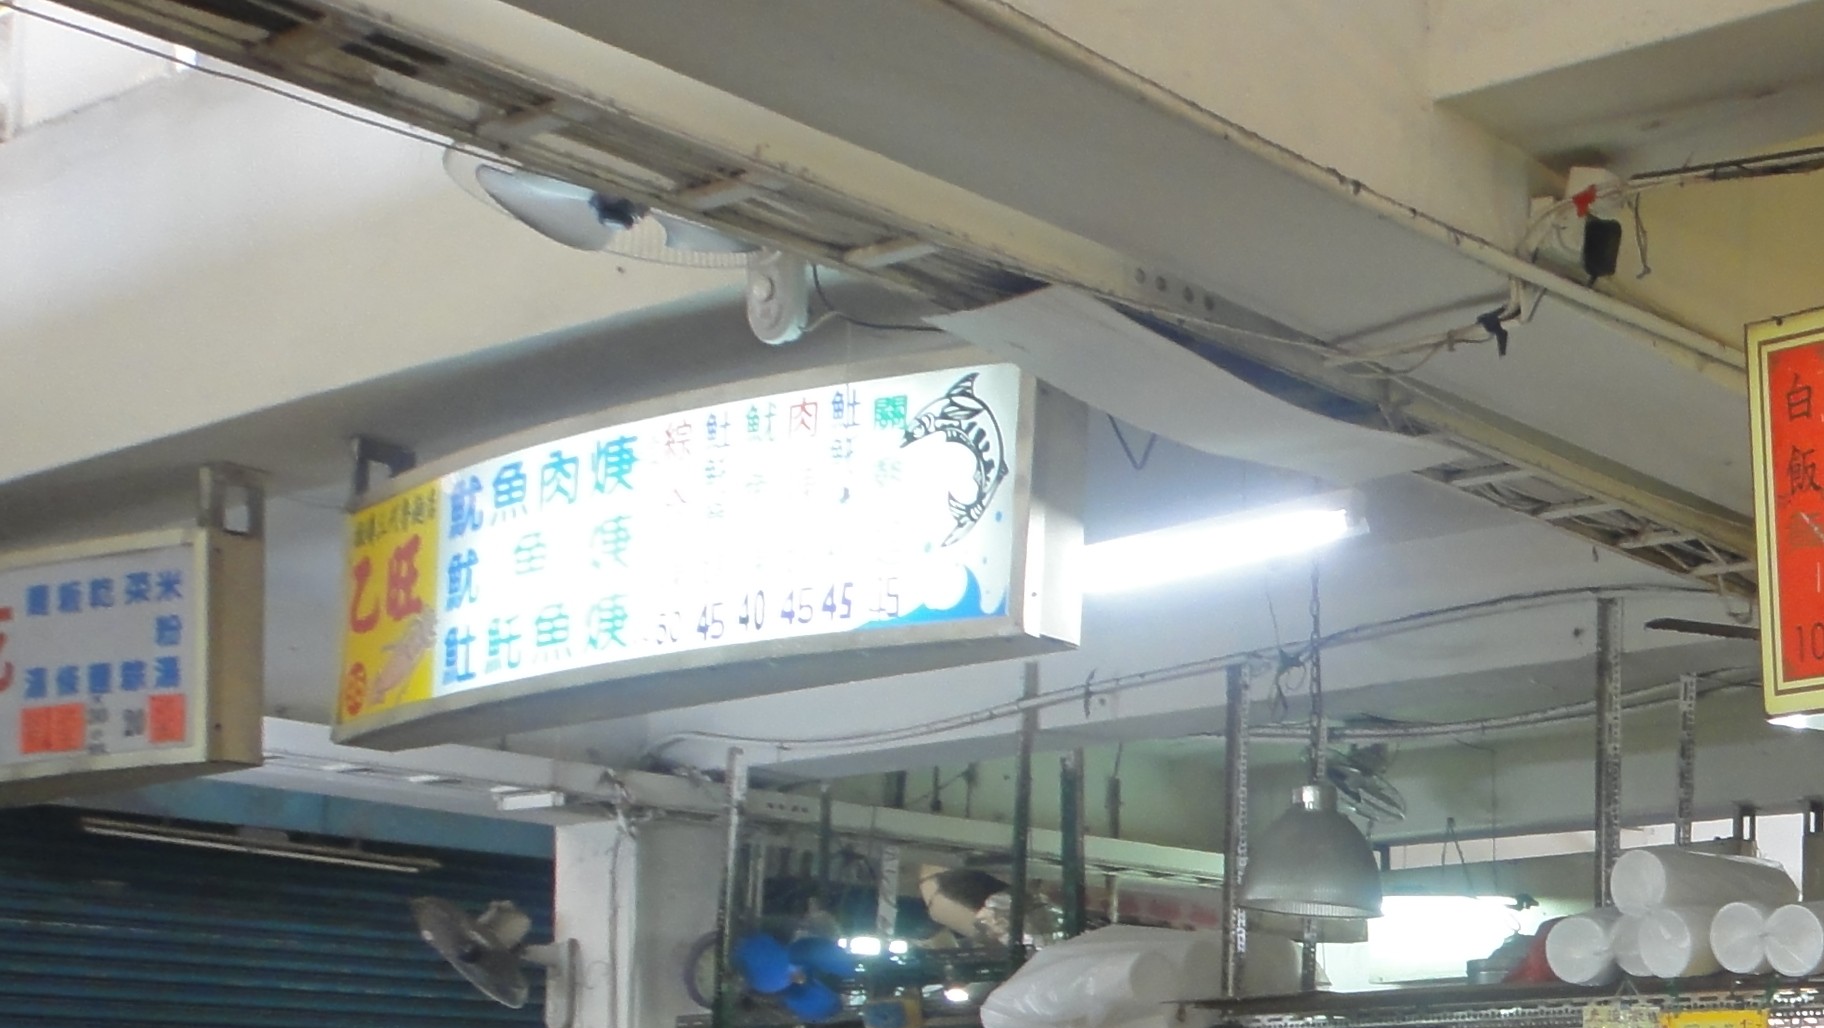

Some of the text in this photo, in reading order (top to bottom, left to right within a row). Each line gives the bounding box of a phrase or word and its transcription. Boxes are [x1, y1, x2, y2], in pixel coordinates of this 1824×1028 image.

[780, 587, 814, 624] 45
[821, 581, 854, 620] 45
[697, 602, 725, 641] 45
